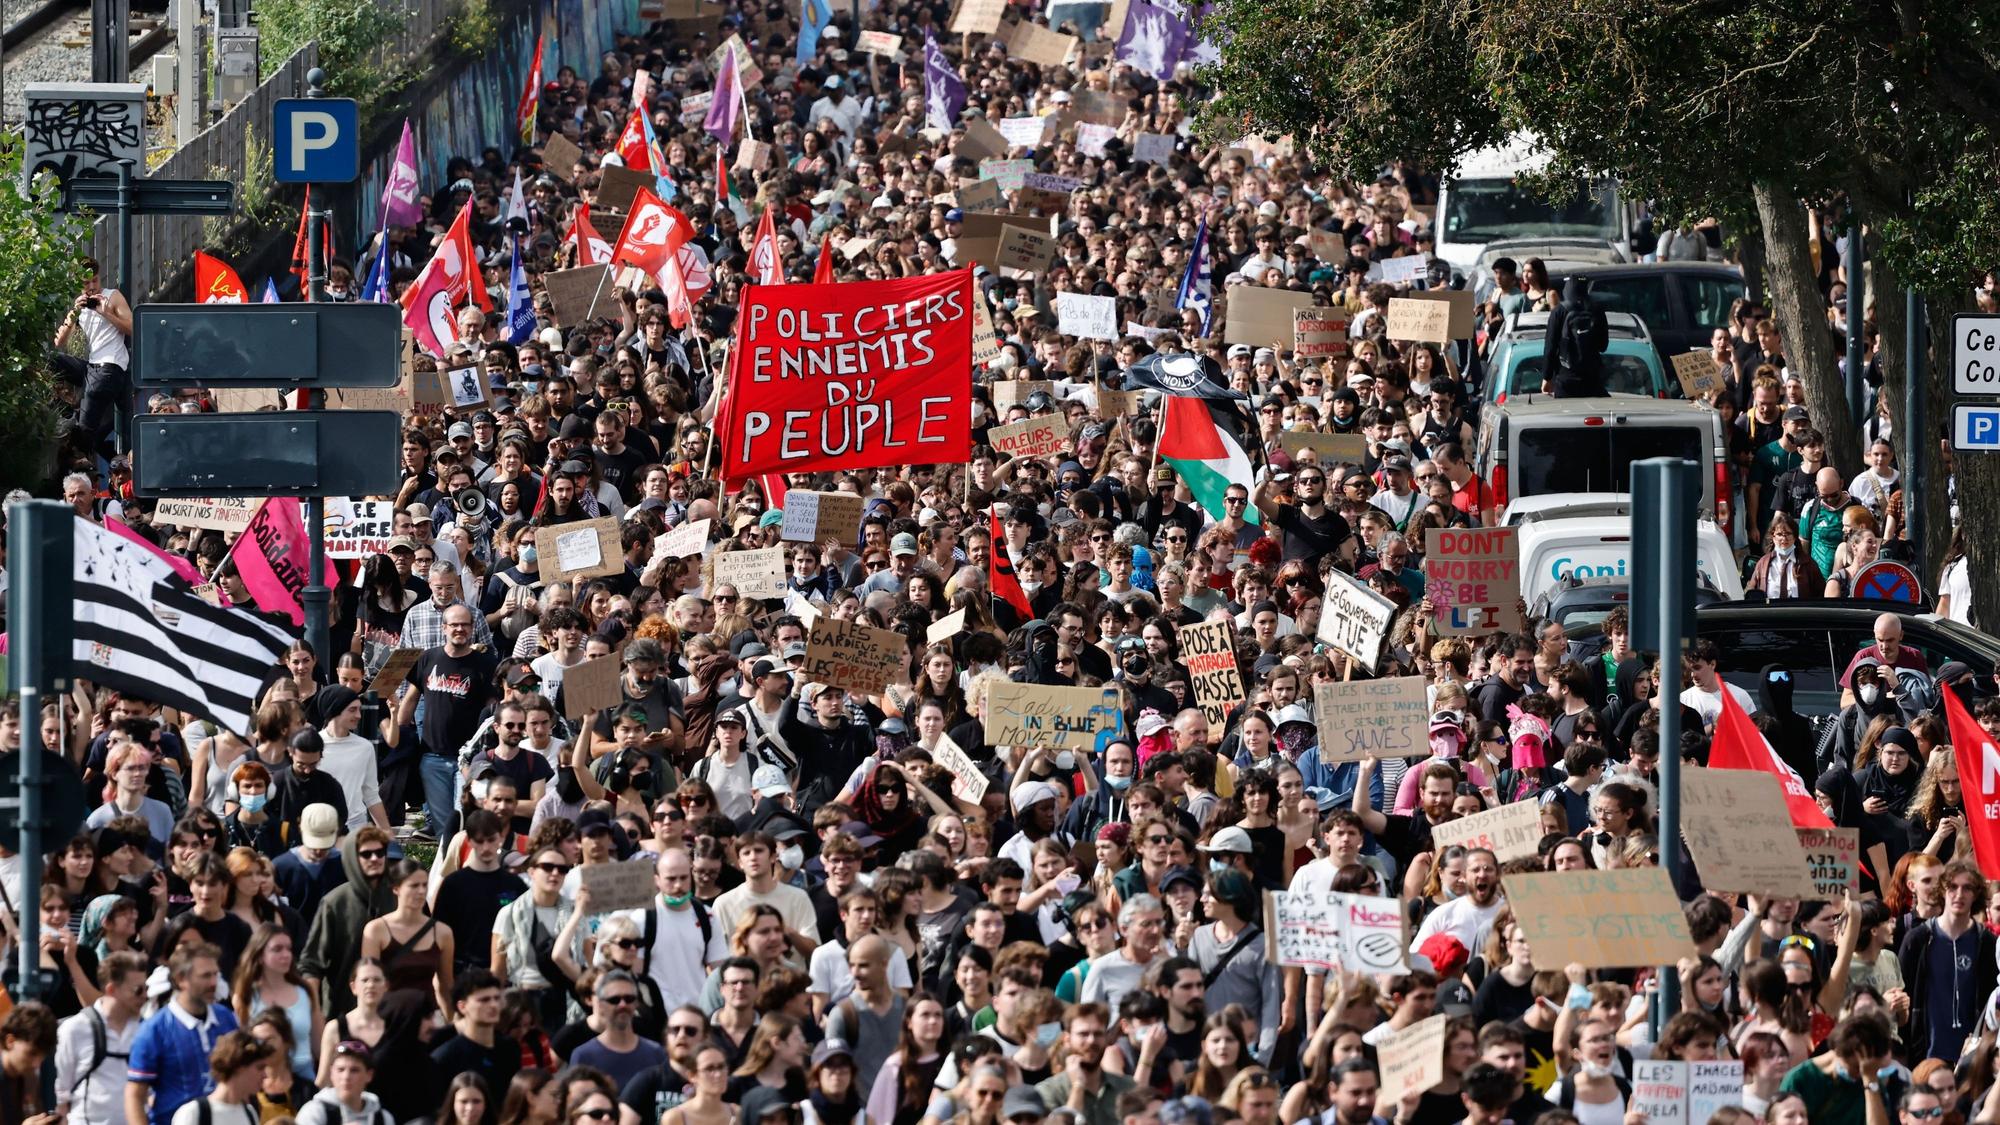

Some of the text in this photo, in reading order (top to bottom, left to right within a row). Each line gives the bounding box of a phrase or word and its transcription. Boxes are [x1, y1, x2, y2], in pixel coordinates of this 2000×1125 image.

[291, 112, 339, 171] P
[749, 290, 964, 342] POLICIERS
[1967, 329, 2000, 351] Ce
[754, 329, 935, 382] ENNEMIS
[1163, 373, 1195, 388] ACTION
[1966, 360, 2000, 382] Co
[826, 379, 876, 406] DU
[742, 396, 951, 463] PEUPLE
[1975, 418, 1992, 439] P
[992, 427, 1054, 453] VIOLEURS
[160, 504, 172, 514] ON
[173, 504, 191, 517] SORT
[196, 507, 212, 519] NOS
[360, 540, 389, 553] FACH
[1439, 531, 1512, 555] DONT
[1428, 560, 1515, 581] WORRY
[1458, 584, 1488, 604] BE
[1451, 607, 1500, 629] LFI
[811, 629, 879, 652] GARDIENS
[838, 621, 872, 641] LES
[1184, 627, 1215, 655] POSE
[1335, 612, 1369, 657] TUE
[804, 657, 834, 677] LES
[1187, 651, 1236, 674] MATRAQUE
[1193, 669, 1242, 702] PASSE
[1024, 715, 1097, 733] IN BLUE
[1198, 704, 1224, 725] TON
[1785, 780, 1808, 796] RÉV
[1437, 824, 1462, 841] UN
[1278, 894, 1314, 905] PAS
[1638, 1064, 1674, 1081] LES
